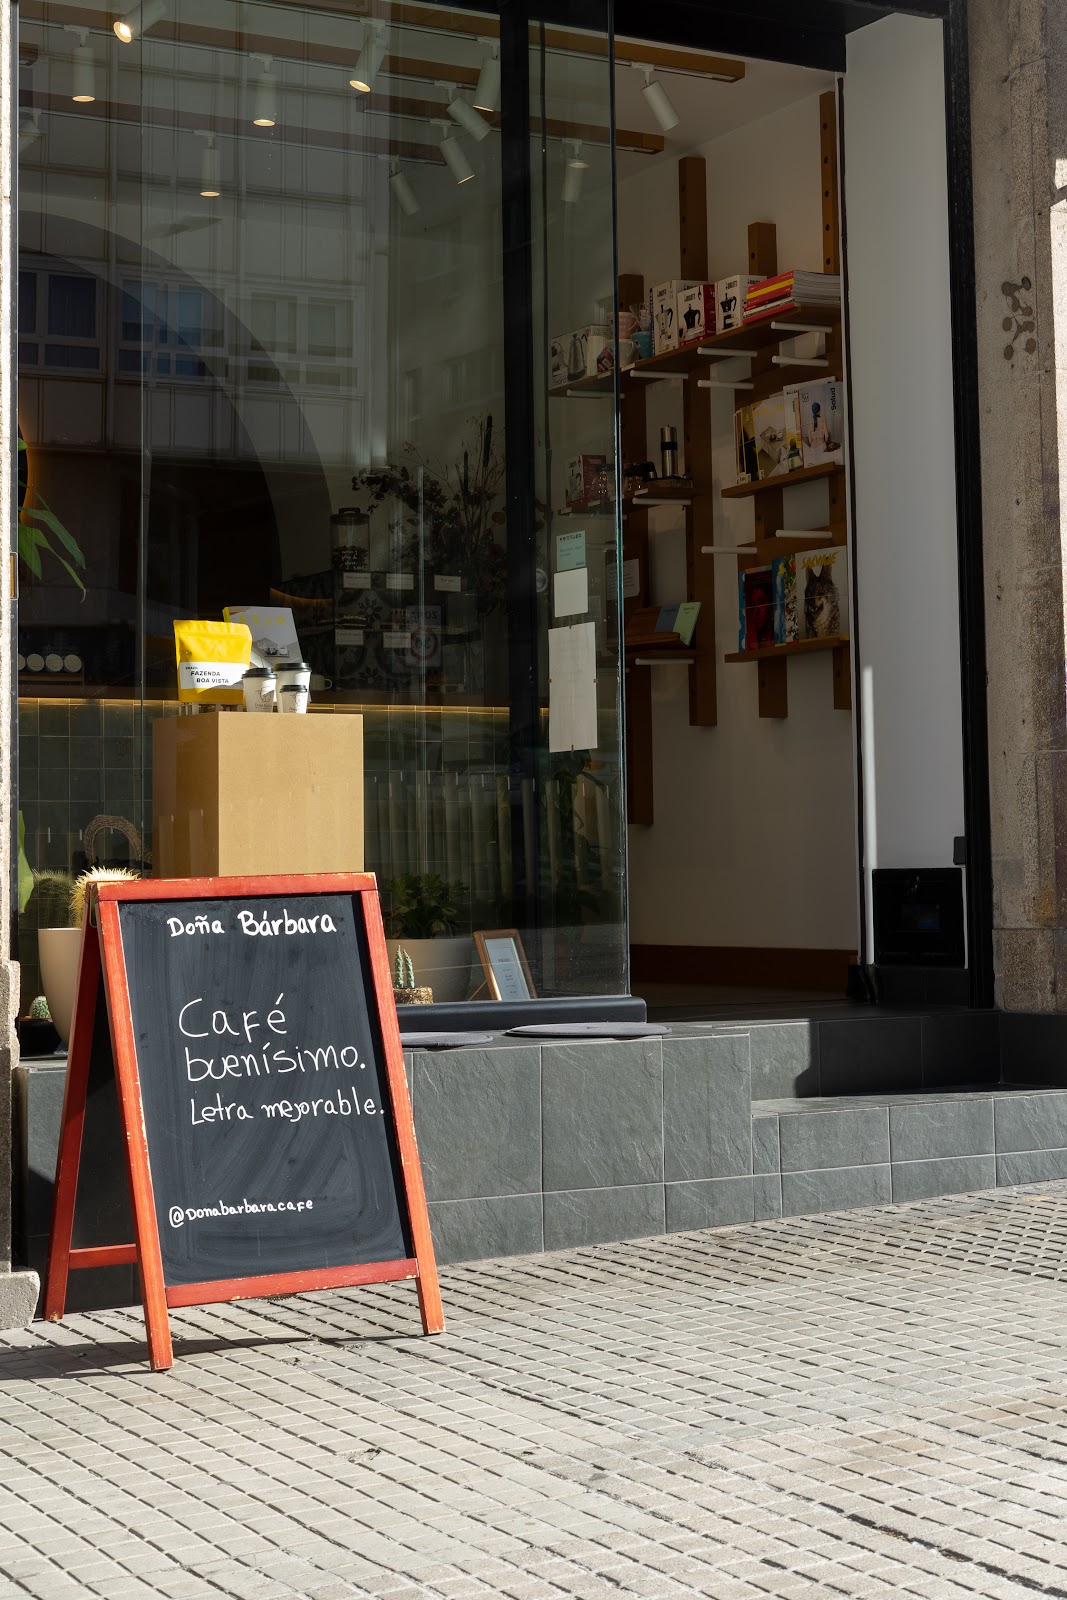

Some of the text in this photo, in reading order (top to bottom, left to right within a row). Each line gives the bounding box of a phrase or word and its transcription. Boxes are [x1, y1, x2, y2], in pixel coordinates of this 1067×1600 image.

[239, 614, 285, 625] SOLO
[166, 908, 338, 938] Doña Bárbara
[178, 993, 288, 1044] Café
[184, 1041, 366, 1082] buenísimo.
[190, 1086, 385, 1126] Letra mejorable.
